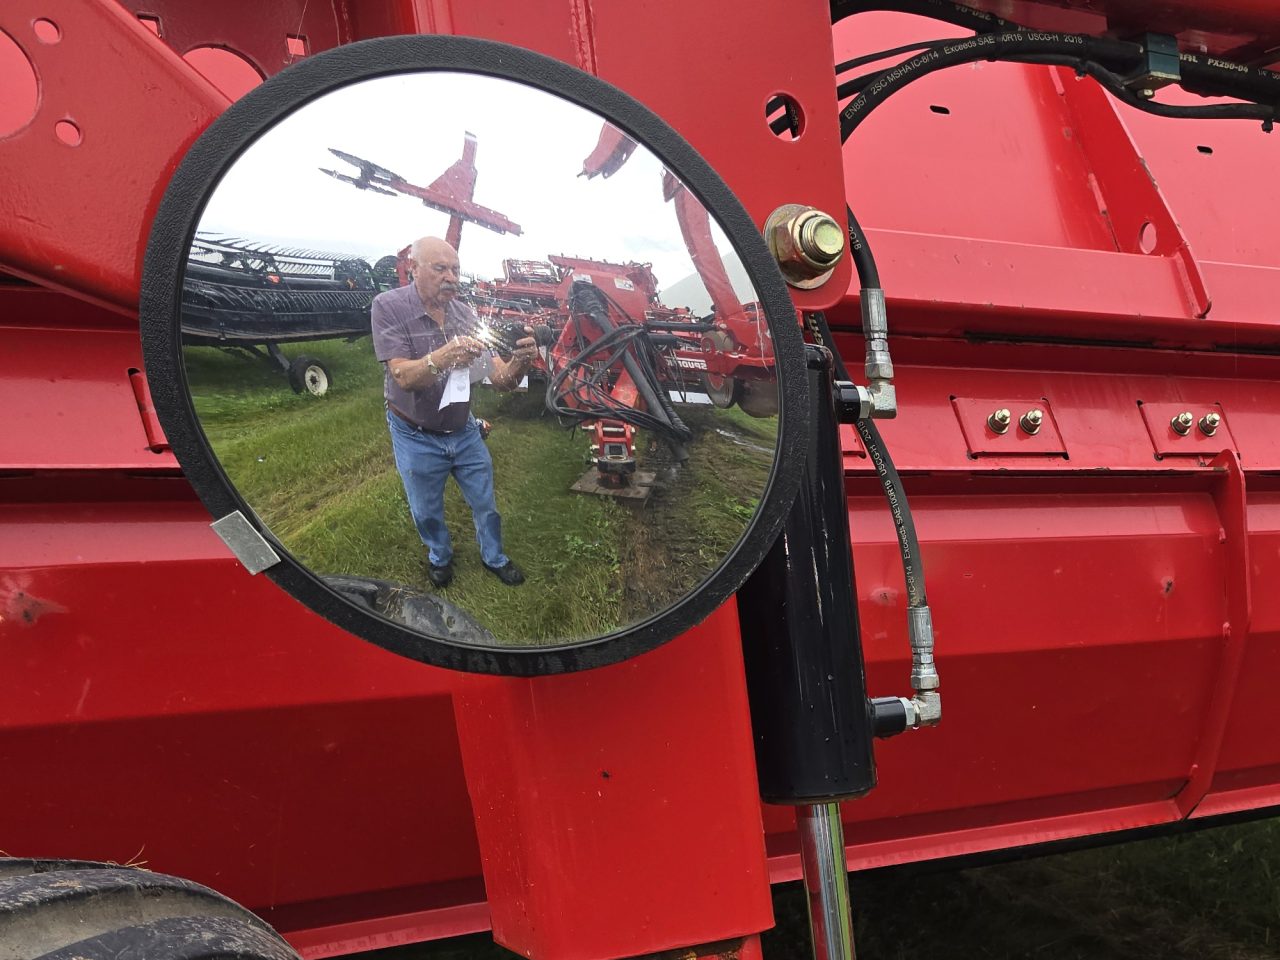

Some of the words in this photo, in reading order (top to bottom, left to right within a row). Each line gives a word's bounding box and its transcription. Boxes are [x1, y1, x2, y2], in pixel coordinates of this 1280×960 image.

[844, 95, 867, 120] EN857
[870, 79, 888, 95] 2SC
[887, 64, 912, 83] MSHA
[911, 50, 939, 68] IC-8/14
[943, 41, 977, 55] Exceeds
[1028, 33, 1059, 42] USCG-H
[1064, 35, 1083, 44] 2Q18
[1207, 58, 1249, 73] PX250-04
[869, 444, 888, 476] USCG-H
[884, 479, 903, 525] SAE100R16
[899, 525, 911, 560] Exceeds
